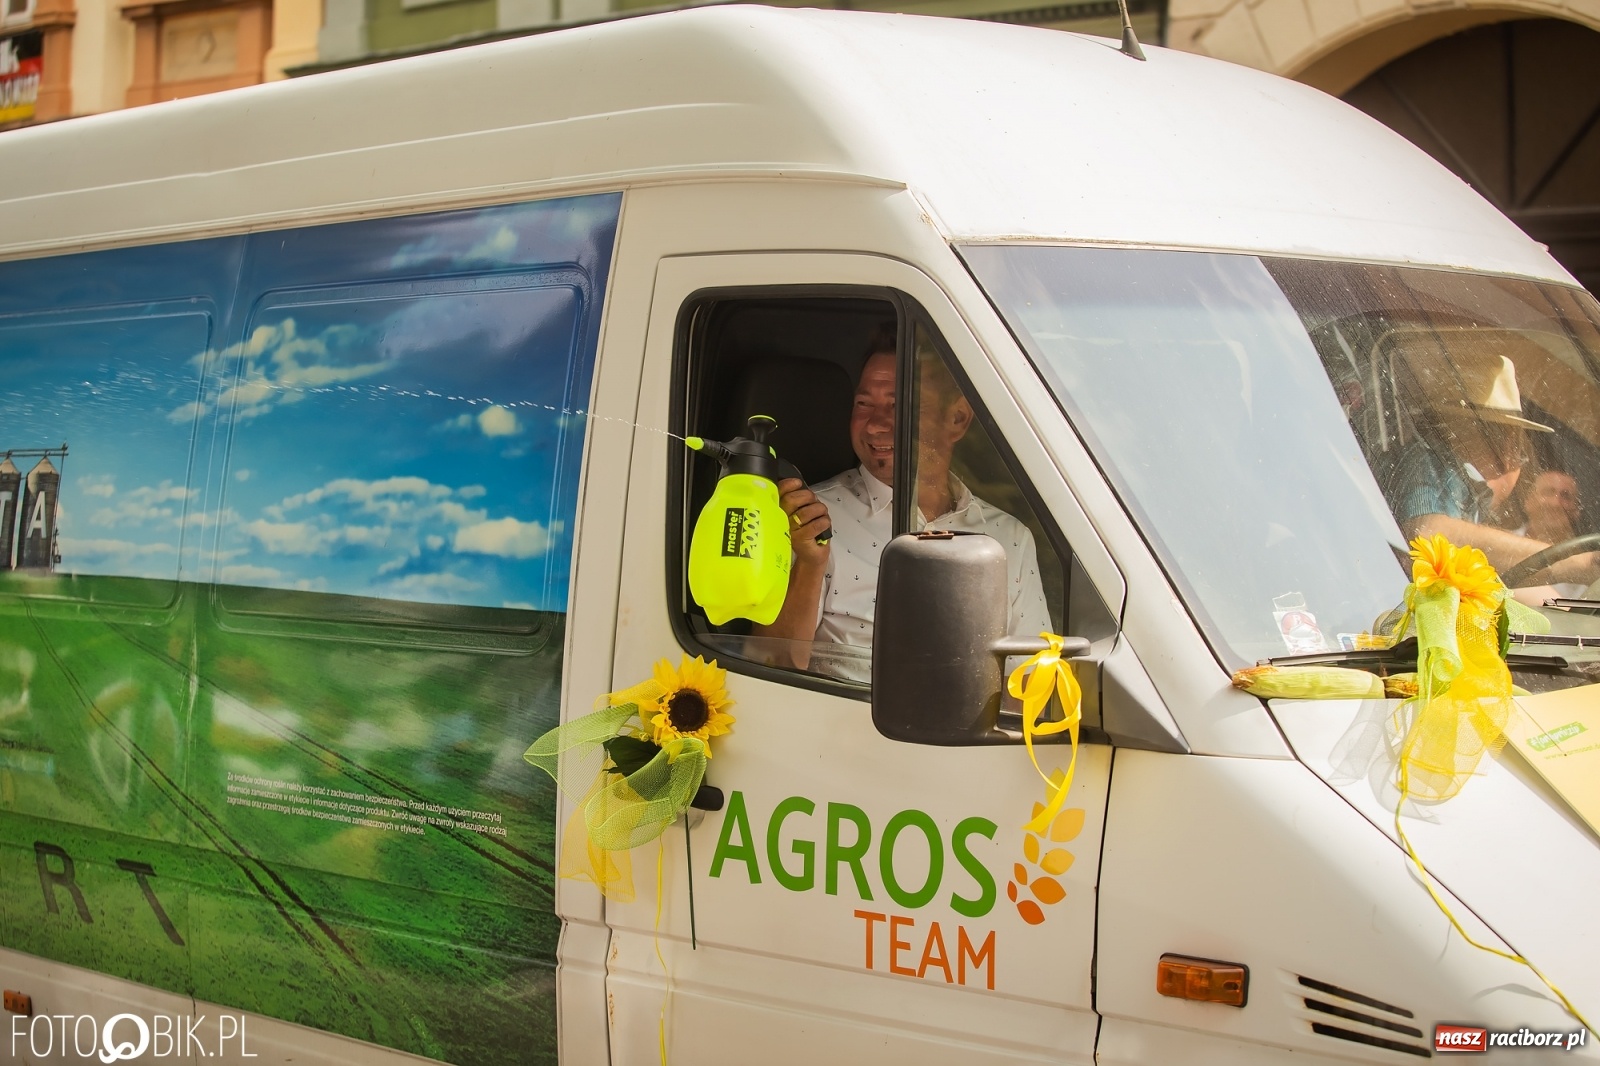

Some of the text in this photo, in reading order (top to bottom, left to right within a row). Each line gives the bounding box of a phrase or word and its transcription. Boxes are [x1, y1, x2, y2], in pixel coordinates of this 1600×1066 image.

[727, 511, 739, 553] master
[740, 508, 760, 559] 2000
[709, 790, 999, 918] AGROS
[854, 909, 996, 990] TEAM
